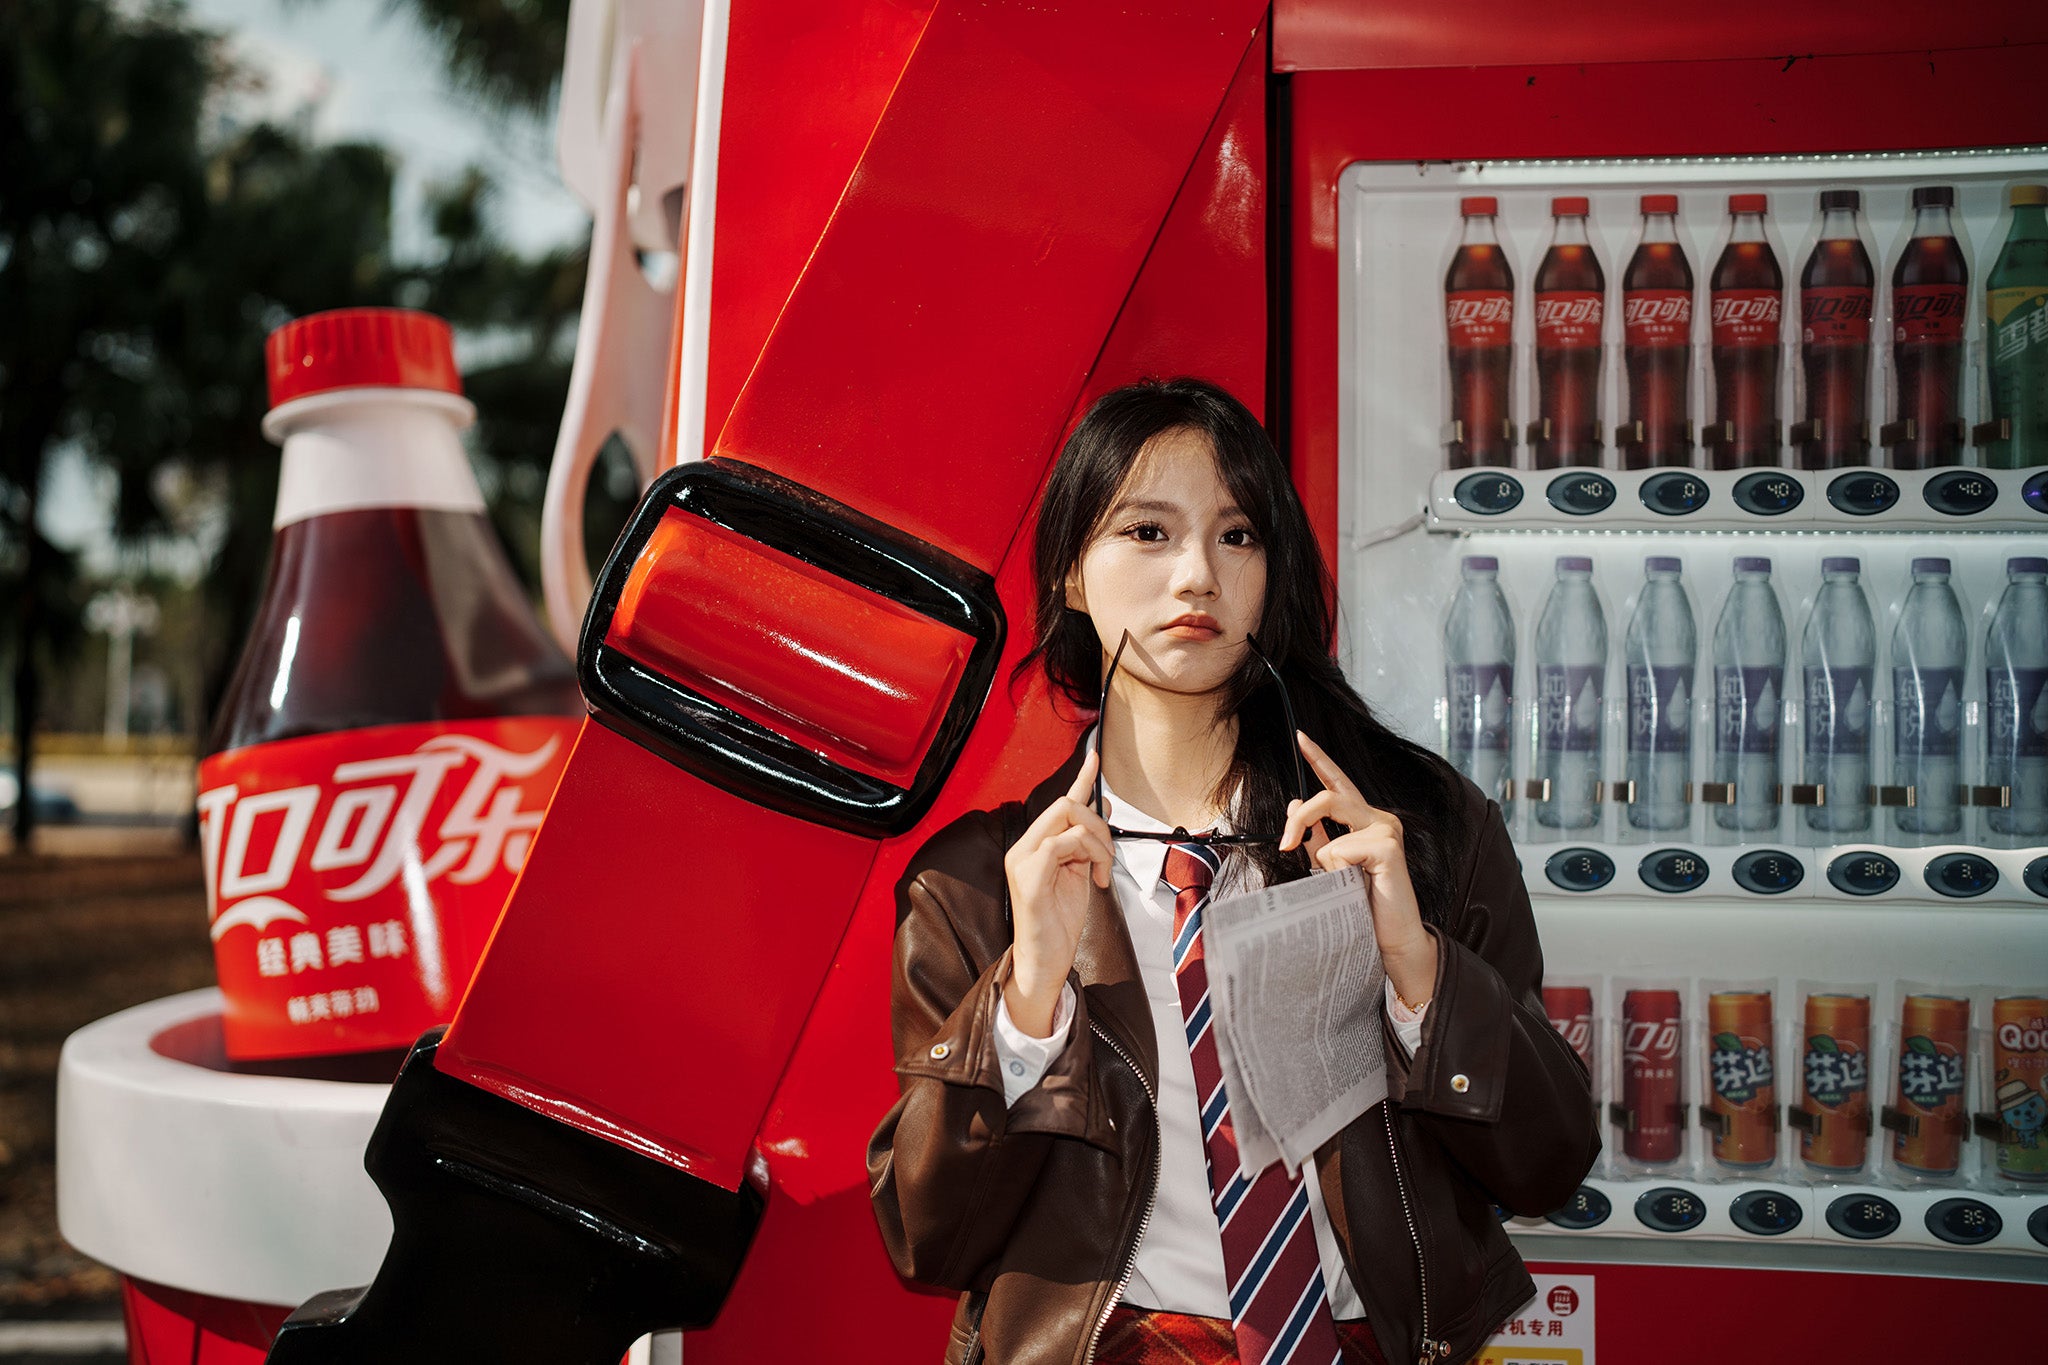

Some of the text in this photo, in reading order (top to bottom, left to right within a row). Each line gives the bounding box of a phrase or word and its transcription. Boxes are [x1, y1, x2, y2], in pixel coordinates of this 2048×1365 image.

[1449, 297, 1511, 325] 可口可乐
[1537, 297, 1601, 325] 可口可乐
[1626, 296, 1690, 324] 可口可乐
[1714, 296, 1779, 324] 可口可乐
[257, 919, 409, 977] 经典美味
[1712, 1047, 1772, 1093] 芬达
[1805, 1052, 1867, 1094] 芬达
[1901, 1052, 1963, 1095] 芬达
